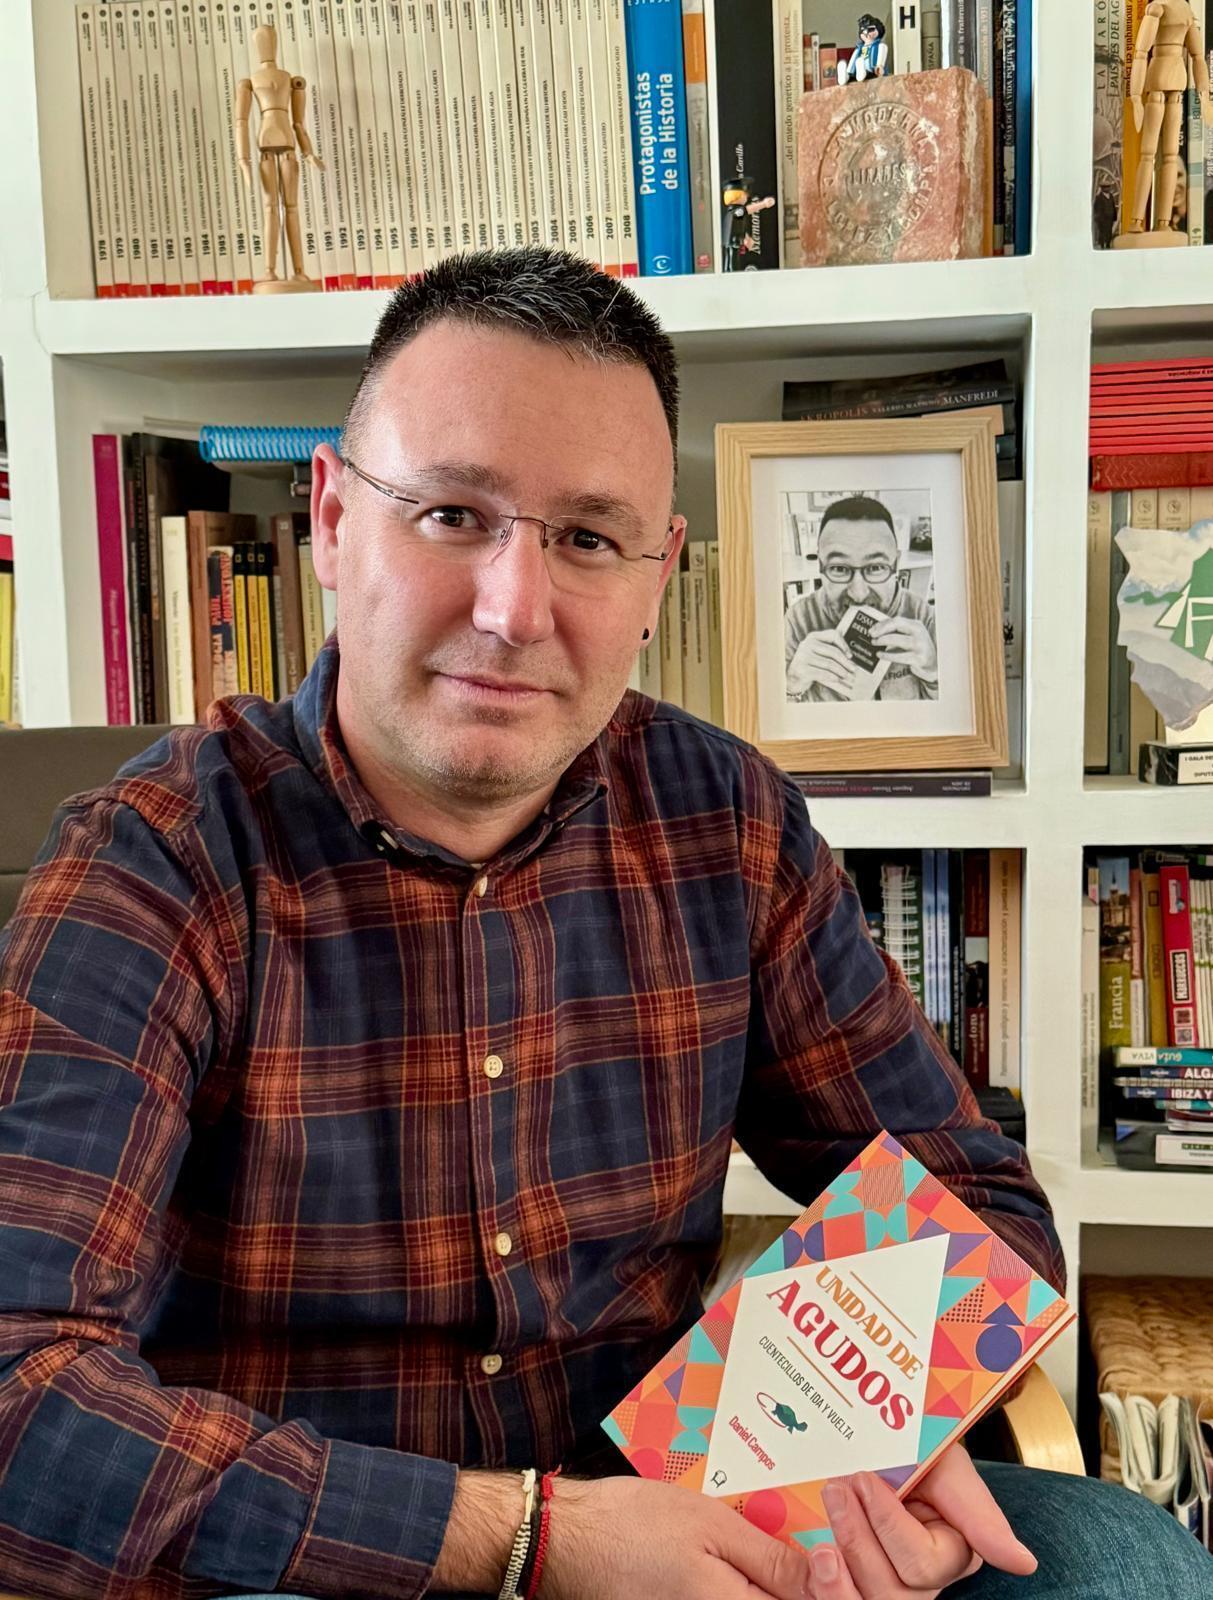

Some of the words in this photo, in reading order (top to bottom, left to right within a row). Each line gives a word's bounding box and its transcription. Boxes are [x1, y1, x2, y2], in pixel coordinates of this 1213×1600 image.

[899, 4, 916, 29] H
[1109, 18, 1119, 39] DEL
[784, 75, 793, 112] genético
[657, 74, 677, 136] Historia
[637, 72, 656, 195] Protagonistas
[661, 142, 677, 164] la
[662, 169, 678, 190] de
[324, 231, 334, 251] 1991
[339, 227, 348, 248] 1992
[356, 230, 365, 251] 1993
[374, 229, 383, 251] 1994
[390, 228, 399, 250] 1995
[410, 228, 418, 249] 1996
[427, 228, 435, 249] 1997
[444, 226, 452, 248] 1998
[463, 223, 471, 245] 1999
[480, 224, 488, 247] 2000
[515, 222, 524, 245] 2002
[551, 220, 559, 242] 2004
[98, 240, 107, 260] 1978
[116, 237, 124, 258] 1979
[132, 238, 142, 260] 1980
[150, 239, 160, 259] 1981
[166, 238, 174, 260] 1982
[184, 236, 192, 258] 1983
[202, 234, 210, 255] 1984
[218, 235, 226, 256] 1985
[236, 234, 244, 255] 1986
[253, 234, 262, 256] 1987
[306, 233, 316, 255] 1990
[942, 390, 998, 404] MANFREDI
[1108, 976, 1124, 1028] Francia
[1171, 1088, 1202, 1098] IBIZA
[1204, 1088, 1213, 1098] Y
[816, 1265, 892, 1347] UNIDAD
[887, 1340, 924, 1380] DE
[766, 1279, 914, 1431] AGUDOS
[759, 1336, 805, 1386] CUENTECILLOS
[800, 1381, 814, 1395] DE
[809, 1392, 825, 1409] IDA
[821, 1402, 830, 1414] Y
[827, 1409, 854, 1440] VUELTA
[729, 1415, 751, 1443] Daniel
[747, 1437, 776, 1471] Campos
